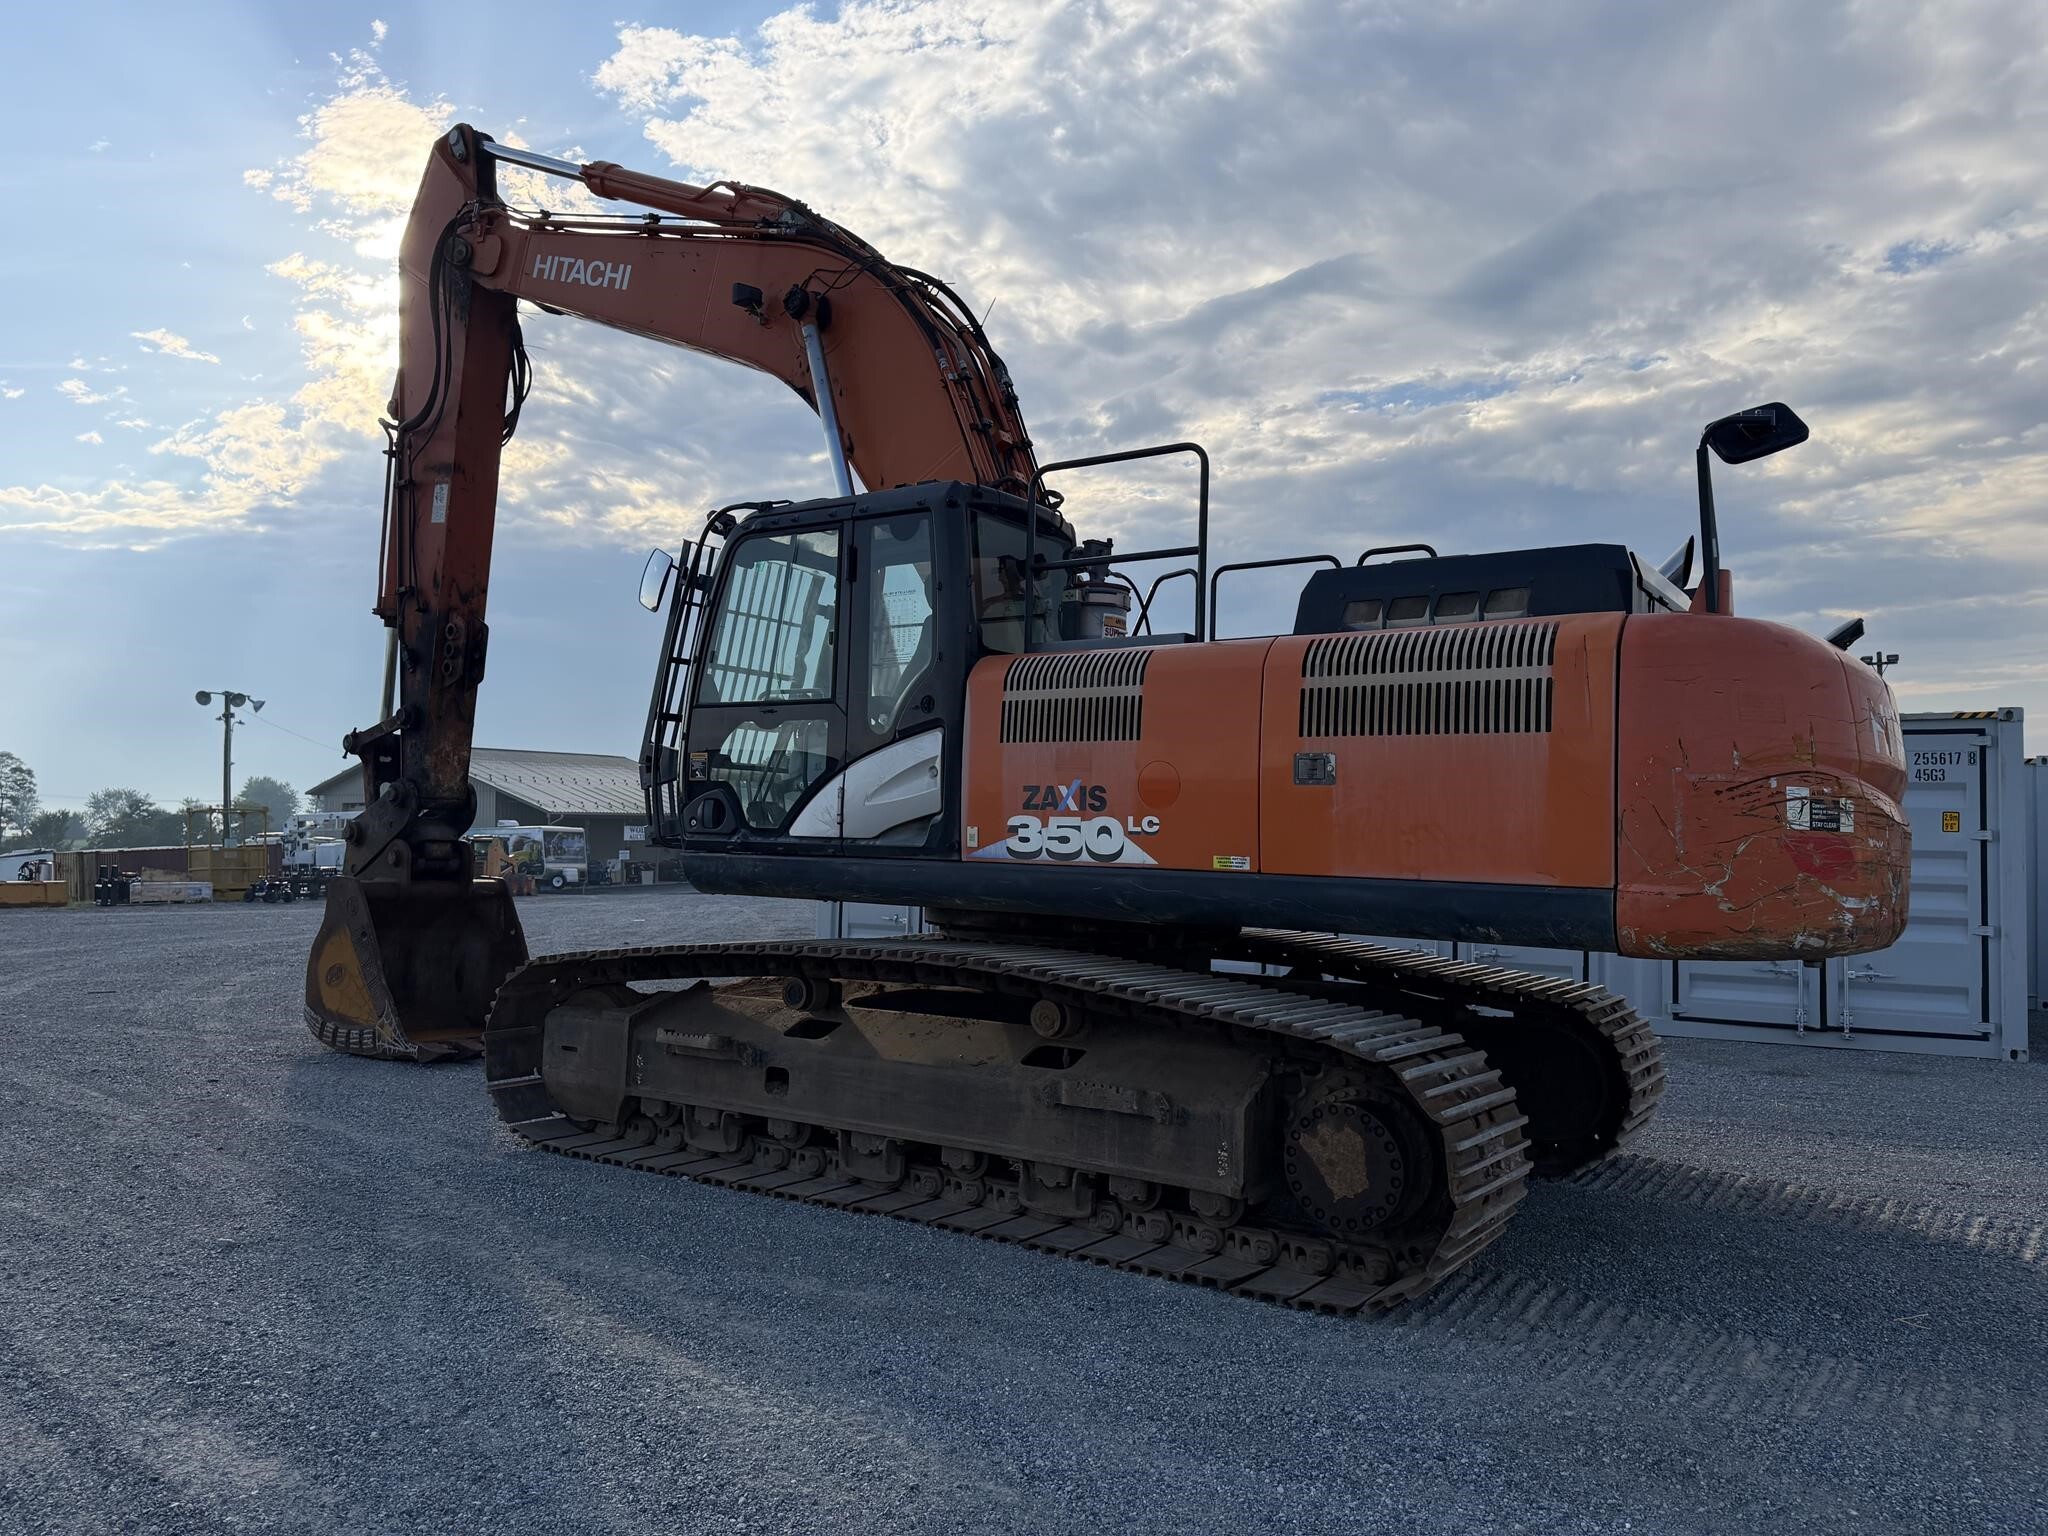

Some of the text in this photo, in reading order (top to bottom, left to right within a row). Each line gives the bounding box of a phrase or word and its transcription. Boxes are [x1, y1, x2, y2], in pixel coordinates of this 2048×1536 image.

[532, 254, 632, 290] HITACHI
[1914, 751, 1977, 766] 255617 8
[1915, 768, 1946, 781] 45G3
[1022, 778, 1107, 812] ZAXIS
[1006, 815, 1160, 862] 350 LC
